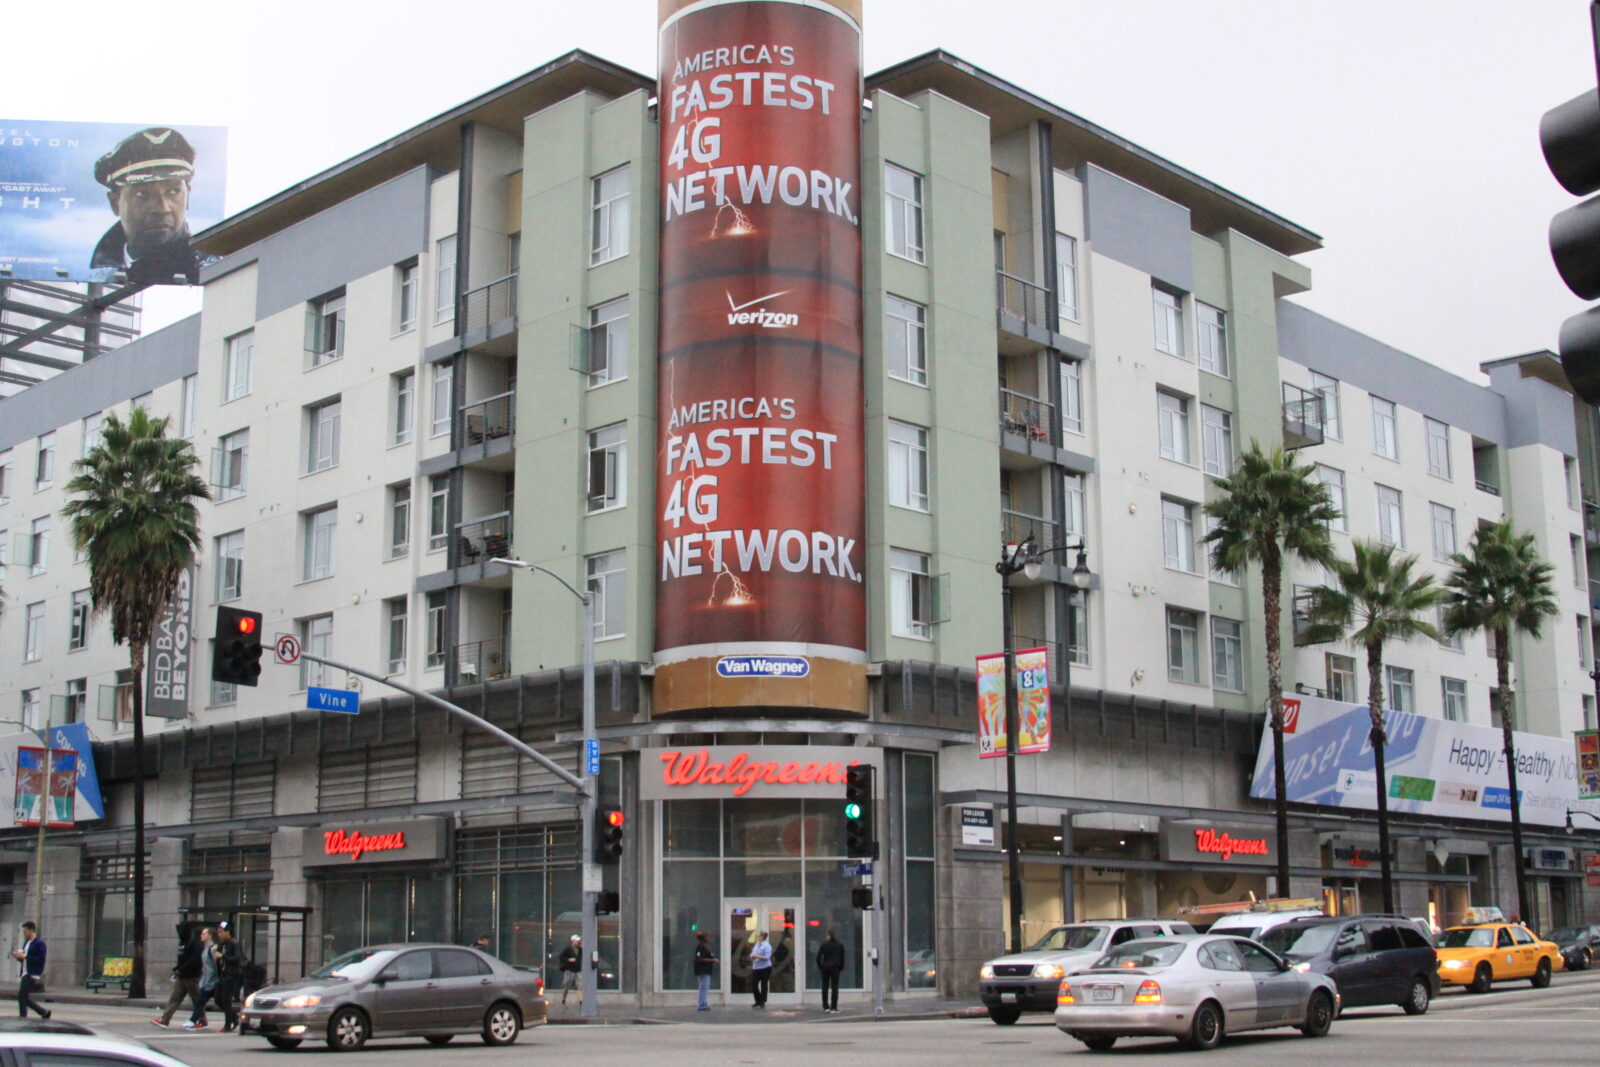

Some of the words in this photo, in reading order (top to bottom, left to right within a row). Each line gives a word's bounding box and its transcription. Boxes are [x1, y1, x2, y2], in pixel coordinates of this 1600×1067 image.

[672, 44, 795, 79] AMERICA'S
[670, 71, 835, 124] FASTEST
[667, 116, 721, 171] 4G
[665, 164, 859, 227] NETWORK.
[727, 308, 799, 328] verizon
[669, 396, 796, 429] AMERICA'S
[666, 426, 838, 476] FASTEST
[663, 474, 718, 529] 4G
[661, 528, 863, 584] NETWORK.
[172, 567, 191, 701] BEYOND
[153, 653, 172, 700] BED
[719, 659, 749, 673] Van
[750, 659, 805, 675] Wagner
[319, 692, 347, 708] Vine
[1449, 737, 1496, 775] Happy
[323, 828, 406, 861] Walgreens
[1194, 828, 1269, 861] Walgreens
